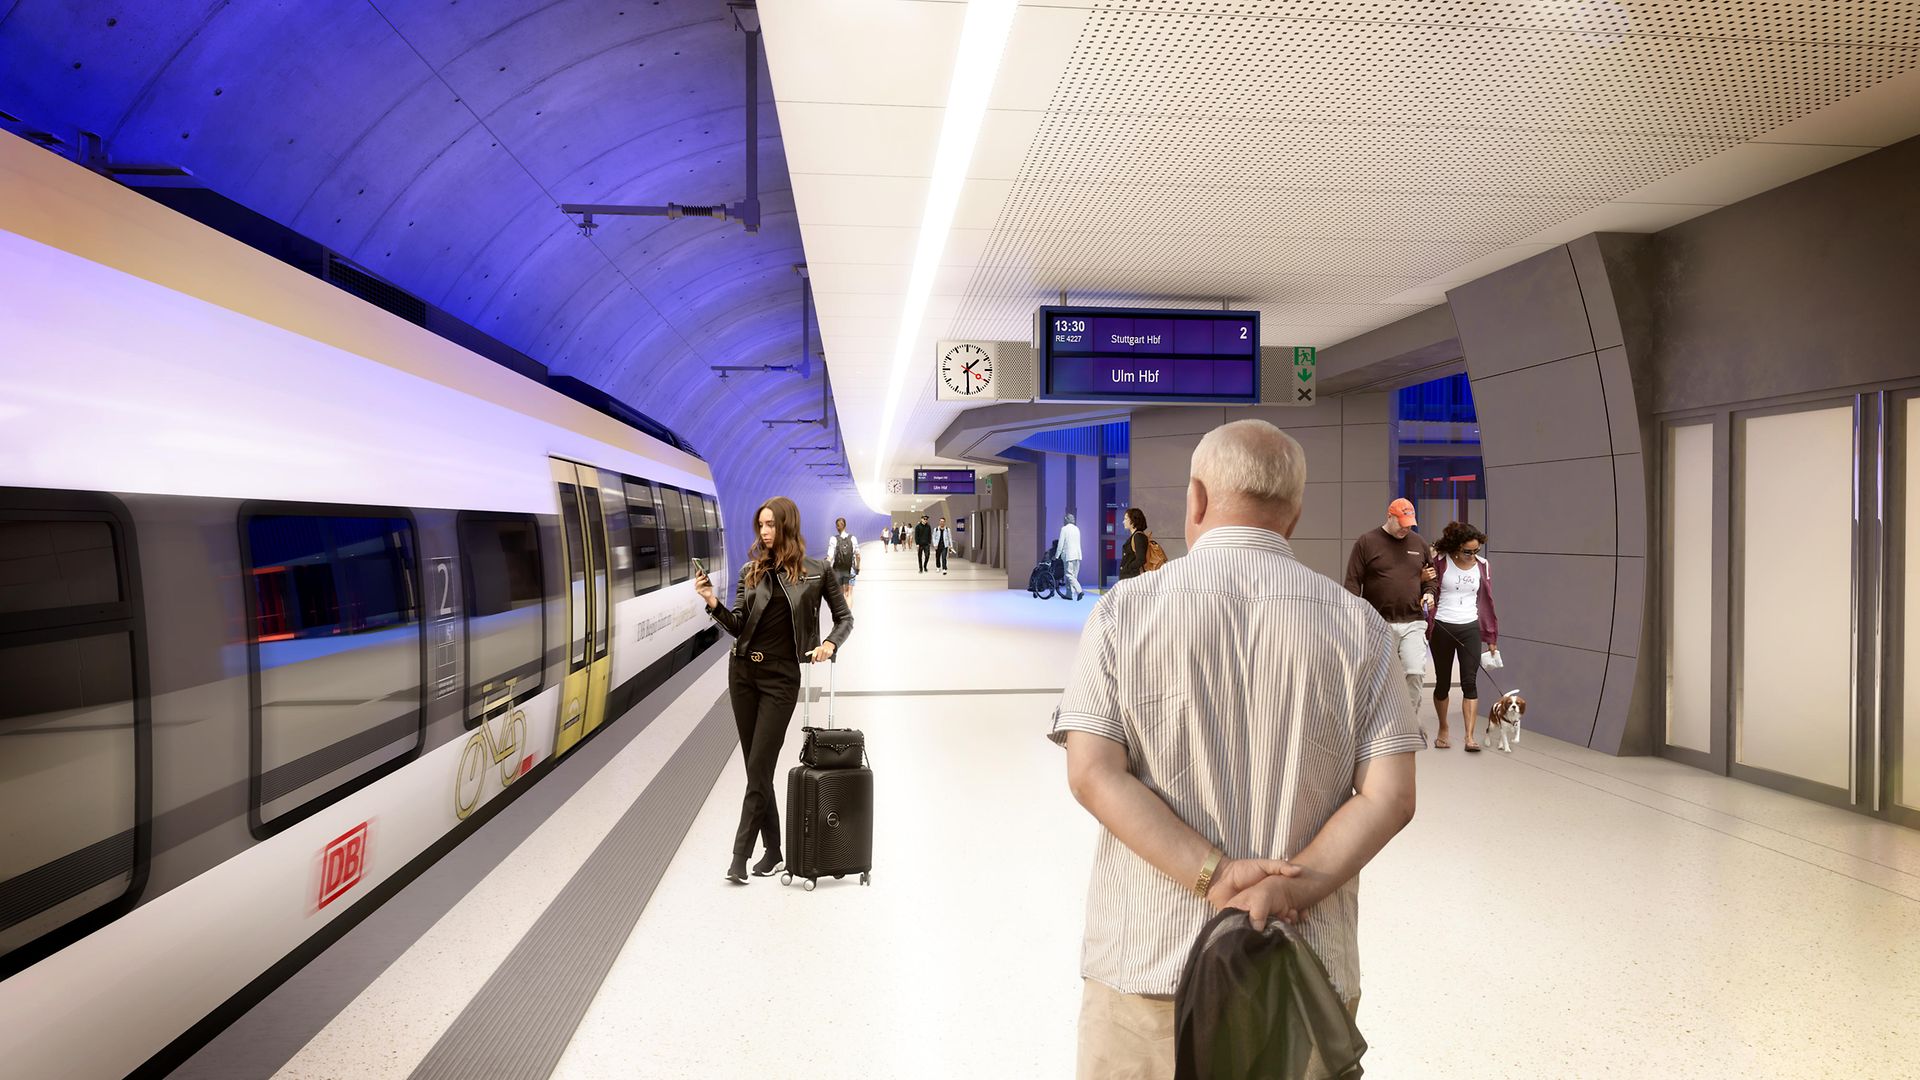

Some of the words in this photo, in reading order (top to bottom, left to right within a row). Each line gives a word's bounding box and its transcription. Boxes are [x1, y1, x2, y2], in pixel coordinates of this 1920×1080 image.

[1055, 320, 1085, 332] 13:30
[1239, 326, 1248, 340] 2
[1055, 334, 1065, 343] RE
[1066, 335, 1082, 343] 4227
[1111, 334, 1145, 346] Stuttgart
[1147, 335, 1161, 345] Hbf
[1111, 369, 1135, 383] Ulm
[1139, 369, 1160, 383] Hbf
[436, 562, 452, 616] 2
[325, 835, 361, 896] DB
